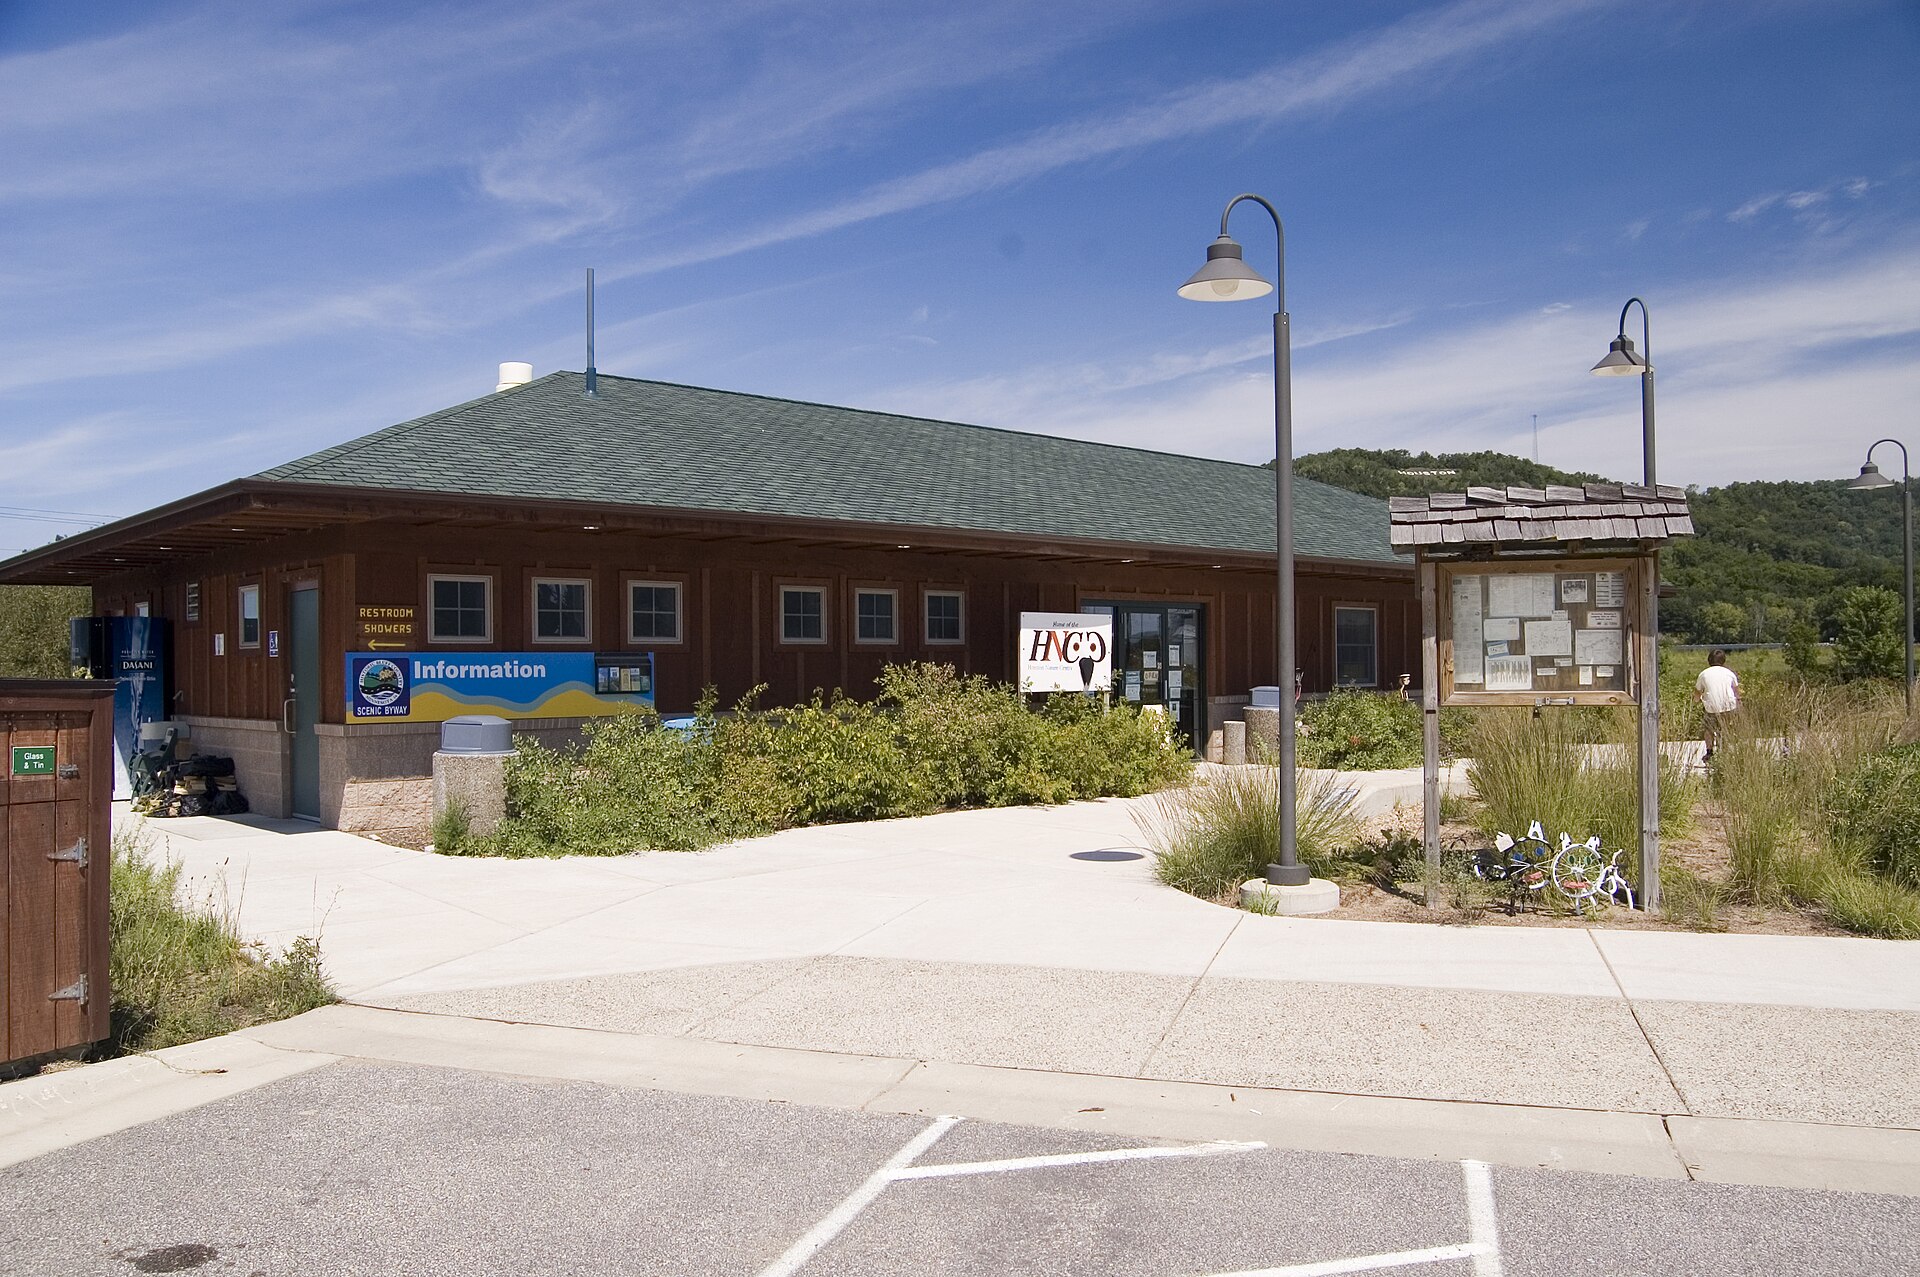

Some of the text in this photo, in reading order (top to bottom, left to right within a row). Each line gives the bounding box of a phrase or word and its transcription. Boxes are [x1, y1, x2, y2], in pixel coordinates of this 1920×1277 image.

[359, 608, 413, 618] RESTROOM
[364, 624, 412, 634] SHOWERS
[123, 660, 153, 669] DASANI
[414, 660, 546, 679] Information
[357, 705, 408, 716] SCENIC BYWAY
[24, 752, 44, 760] Glass
[33, 761, 44, 769] Tin
